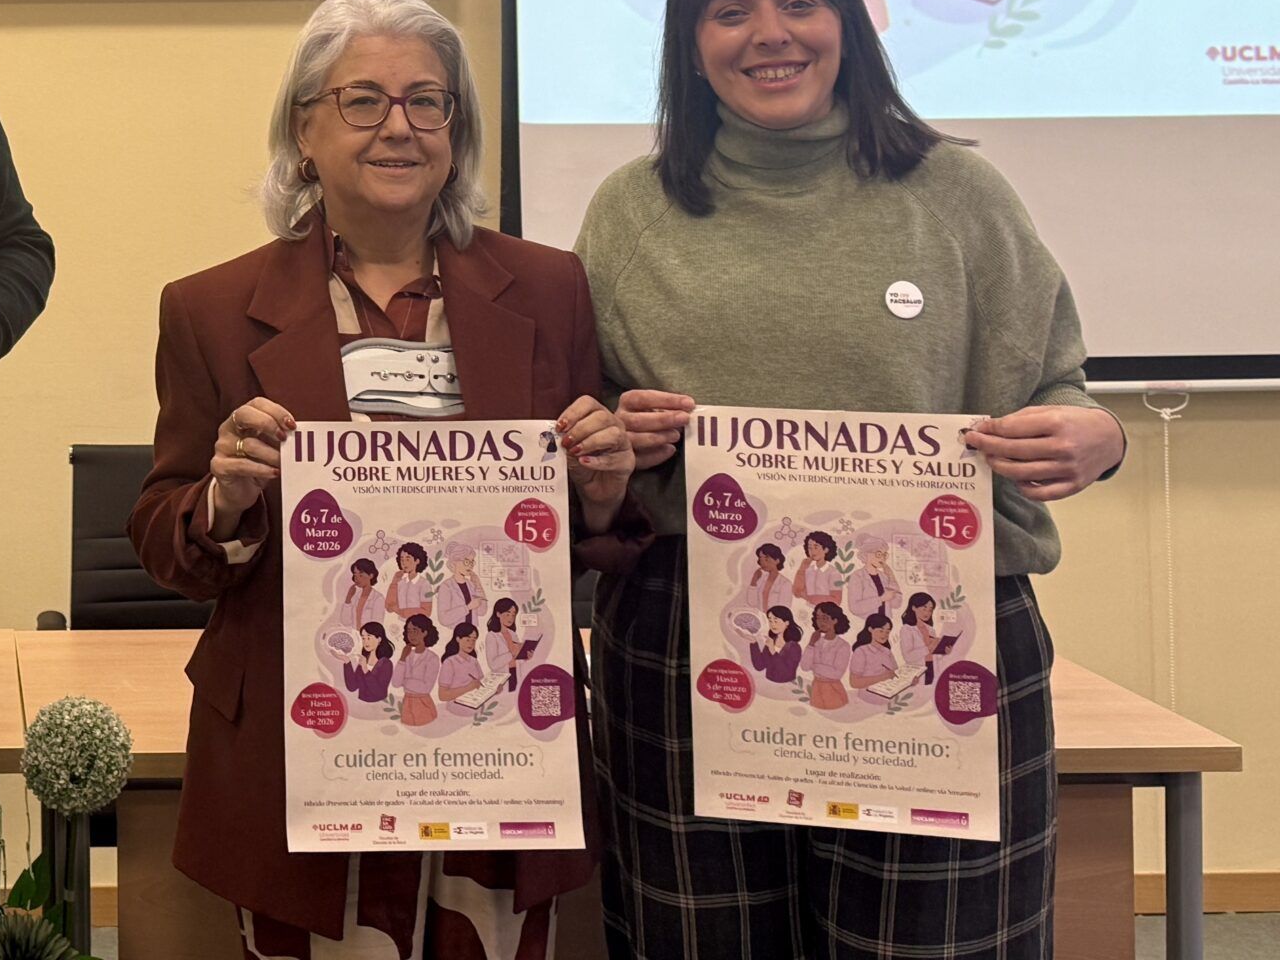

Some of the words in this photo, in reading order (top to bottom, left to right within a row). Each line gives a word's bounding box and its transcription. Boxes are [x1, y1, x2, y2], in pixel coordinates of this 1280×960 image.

[697, 416, 718, 446] II
[726, 416, 940, 457] JORNADAS
[294, 430, 314, 462] II
[324, 430, 524, 466] JORNADAS
[736, 452, 797, 470] SOBRE
[802, 456, 888, 474] MUJERES
[891, 460, 904, 474] Y
[913, 460, 976, 478] SALUD
[332, 466, 390, 482] SOBRE
[396, 466, 475, 484] MUJERES
[478, 466, 490, 480] Y
[498, 466, 556, 480] SALUD
[757, 471, 787, 481] VISIÓN
[788, 474, 869, 486] INTERDISCIPLINAR
[878, 478, 915, 488] NUEVOS
[916, 480, 976, 490] HORIZONTES
[352, 484, 382, 494] VISIÓN
[383, 486, 458, 494] INTERDISCIPLINAR
[466, 486, 500, 494] NUEVOS
[502, 485, 555, 494] HORIZONTES
[704, 491, 713, 506] 6
[723, 492, 733, 506] 7
[734, 498, 746, 508] de
[300, 508, 310, 524] 6
[320, 508, 330, 524] 7
[330, 514, 342, 524] de
[708, 510, 742, 522] Marzo
[306, 527, 338, 538] Marzo
[515, 519, 538, 542] 15
[542, 528, 553, 542] €
[706, 523, 718, 532] de
[720, 524, 745, 534] 2026
[931, 515, 957, 538] 15
[962, 526, 974, 540] €
[303, 542, 316, 551] de
[316, 542, 340, 551] 2026
[741, 726, 807, 747] cuidar
[812, 733, 838, 748] en
[844, 732, 950, 758] femenino:
[334, 749, 398, 769] cuidar
[403, 752, 428, 768] en
[434, 747, 534, 768] femenino:
[774, 748, 816, 761] ciencia,
[819, 751, 850, 764] salud
[862, 755, 918, 768] sociedad.
[366, 770, 408, 782] ciencia,
[410, 769, 440, 781] salud
[451, 769, 504, 780] sociedad.
